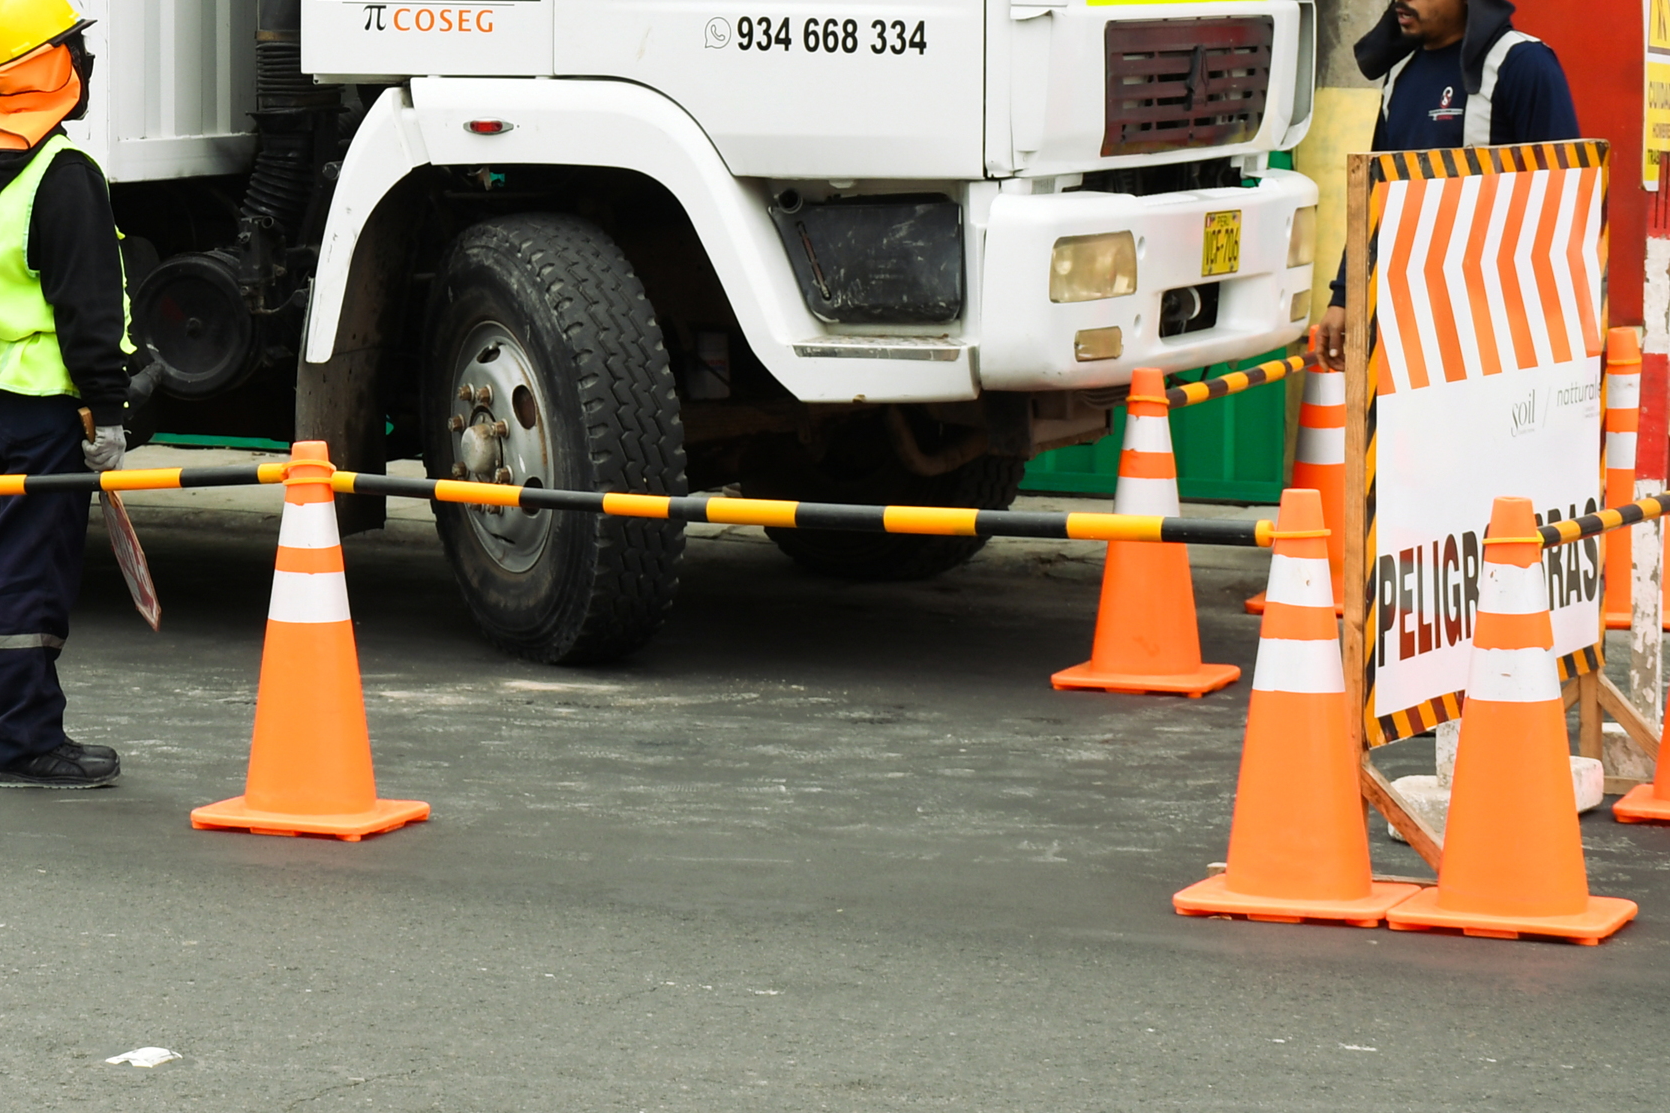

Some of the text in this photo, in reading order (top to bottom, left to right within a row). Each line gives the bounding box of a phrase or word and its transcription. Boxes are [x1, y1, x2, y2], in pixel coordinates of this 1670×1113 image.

[737, 16, 927, 55] 934 668 334
[1378, 524, 1489, 667] PELIGR
